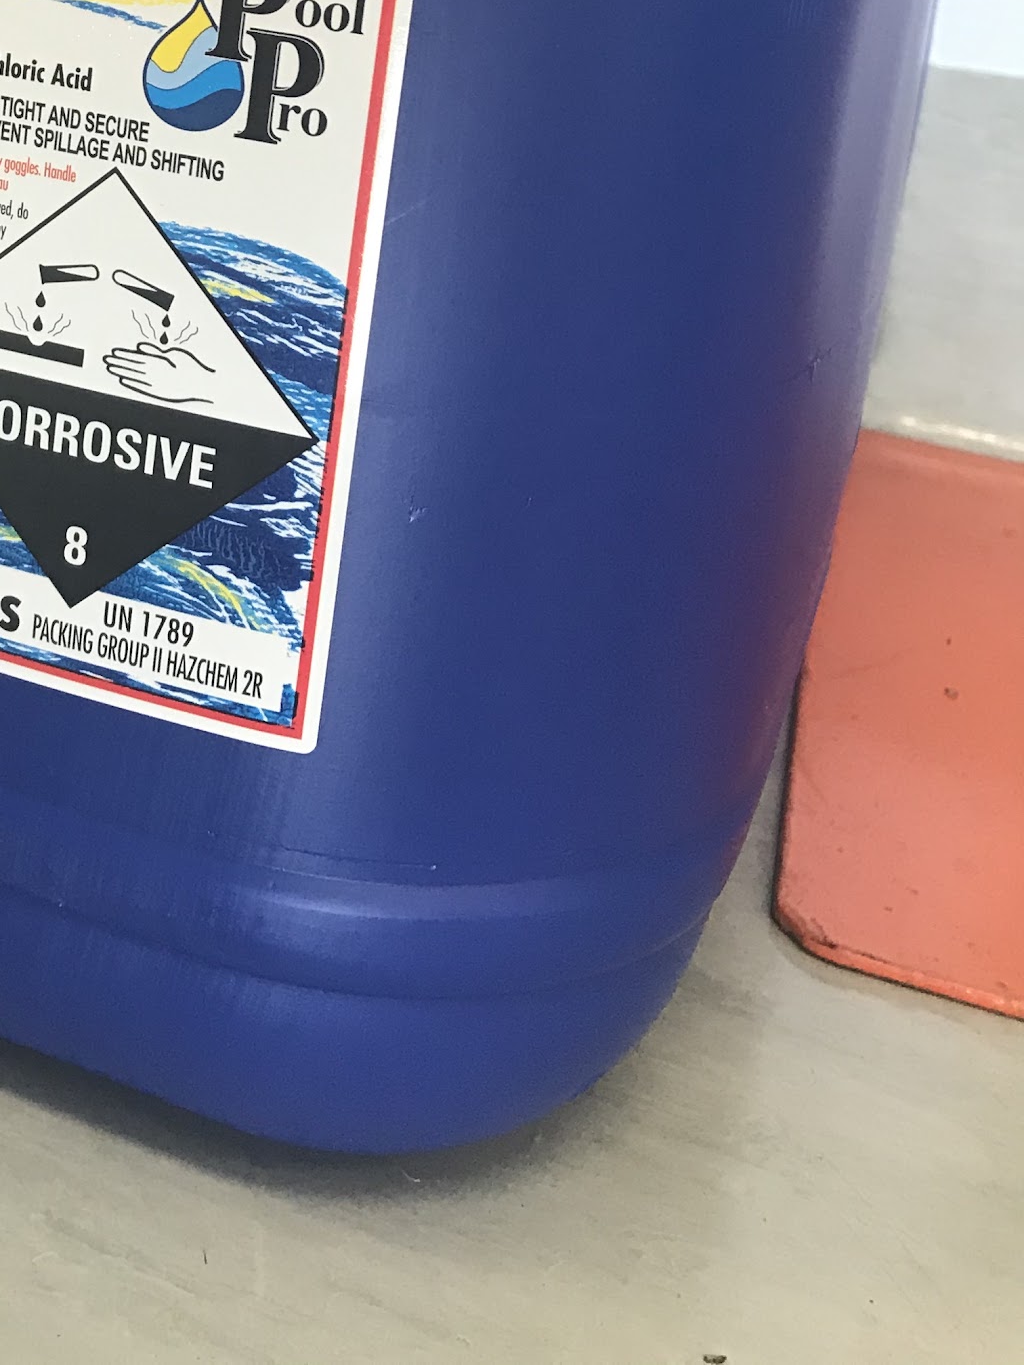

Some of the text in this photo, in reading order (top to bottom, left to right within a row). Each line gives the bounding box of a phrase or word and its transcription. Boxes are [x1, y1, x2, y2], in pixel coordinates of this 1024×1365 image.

[51, 63, 93, 92] Acid
[234, 27, 328, 144] Pro
[0, 95, 46, 123] TIGHT
[47, 105, 81, 129] AND
[84, 111, 150, 143] SECURE
[33, 127, 110, 161] SPILLAGE
[112, 142, 147, 167] AND
[150, 149, 224, 182] SHIFTING
[17, 203, 29, 220] do
[63, 526, 88, 566] 8
[103, 601, 194, 647] UN 1789
[32, 614, 263, 699] PACKING GROUP II HAZCHEM 2R
